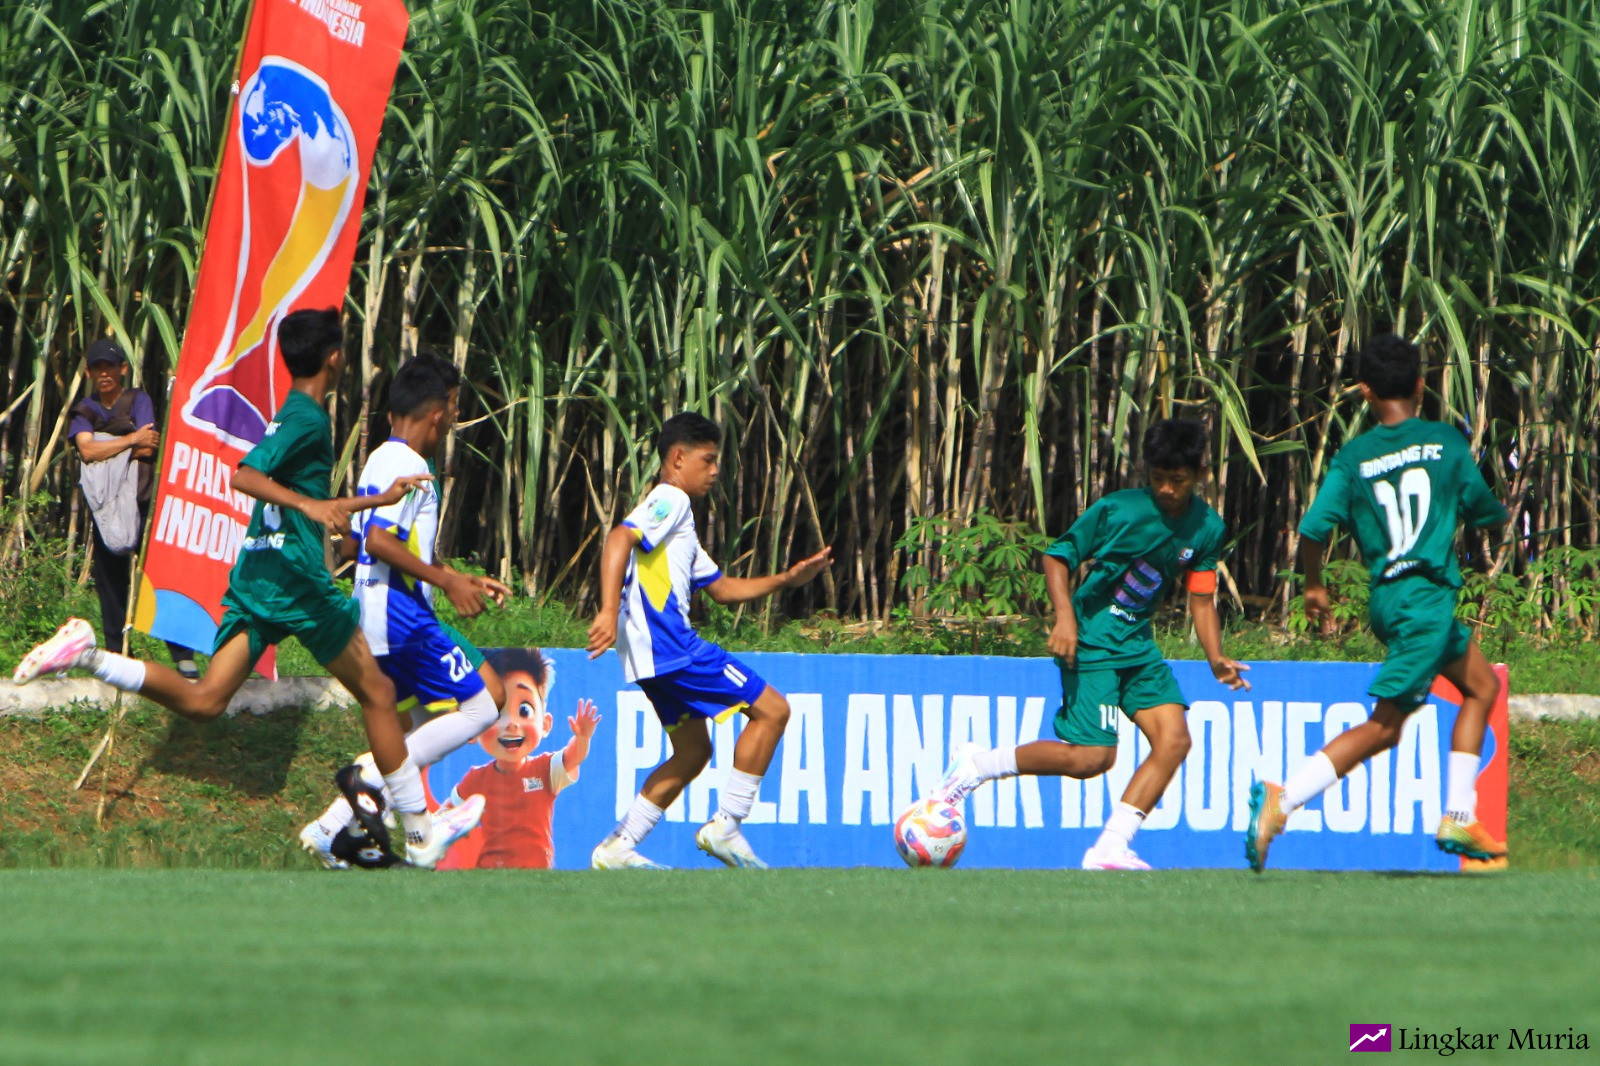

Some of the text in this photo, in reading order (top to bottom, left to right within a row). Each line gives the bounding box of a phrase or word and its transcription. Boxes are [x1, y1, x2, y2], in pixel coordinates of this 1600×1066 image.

[1360, 443, 1444, 478] BINTANG FC
[155, 494, 248, 565] INDON
[1373, 467, 1431, 561] 10
[440, 645, 474, 683] 22
[723, 663, 748, 688] 11
[1098, 704, 1118, 731] 14
